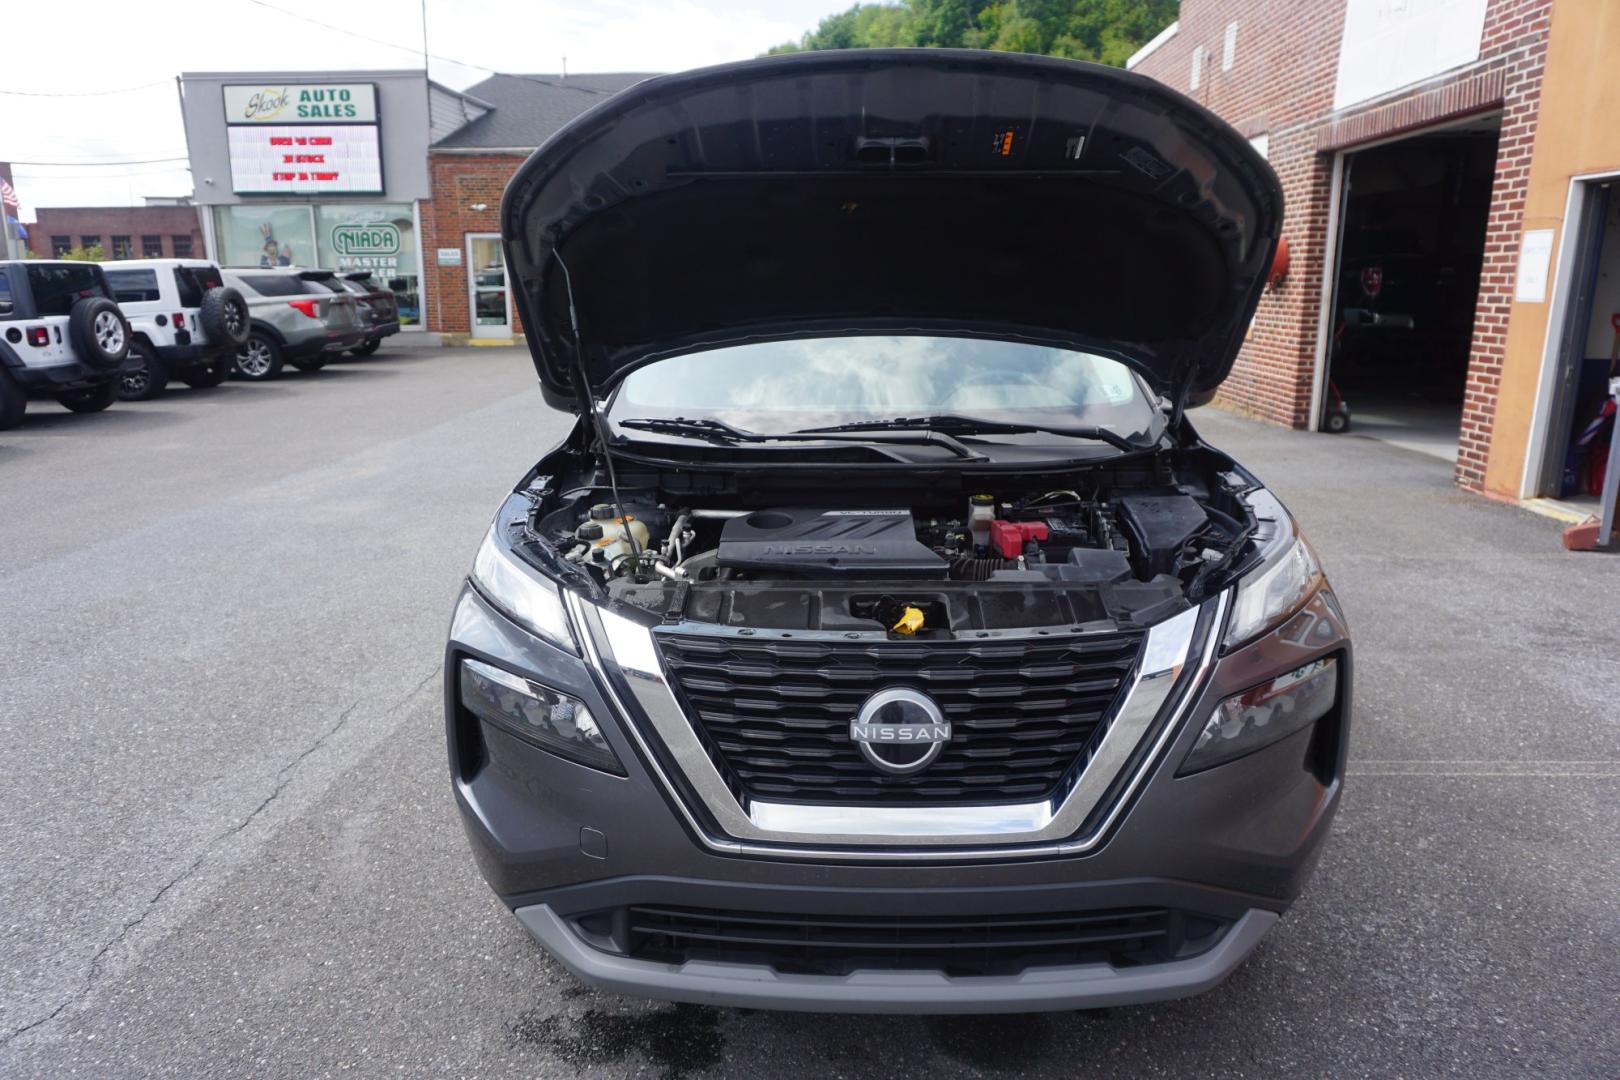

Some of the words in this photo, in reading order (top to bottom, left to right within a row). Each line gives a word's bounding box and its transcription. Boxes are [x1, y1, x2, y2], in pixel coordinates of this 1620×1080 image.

[244, 87, 289, 118] Skook
[299, 89, 351, 102] AUTO
[297, 104, 357, 118] SALES
[338, 231, 394, 249] NIADA
[340, 257, 398, 267] MASTER
[764, 544, 877, 556] NISSAN
[853, 726, 949, 740] NISSAN
